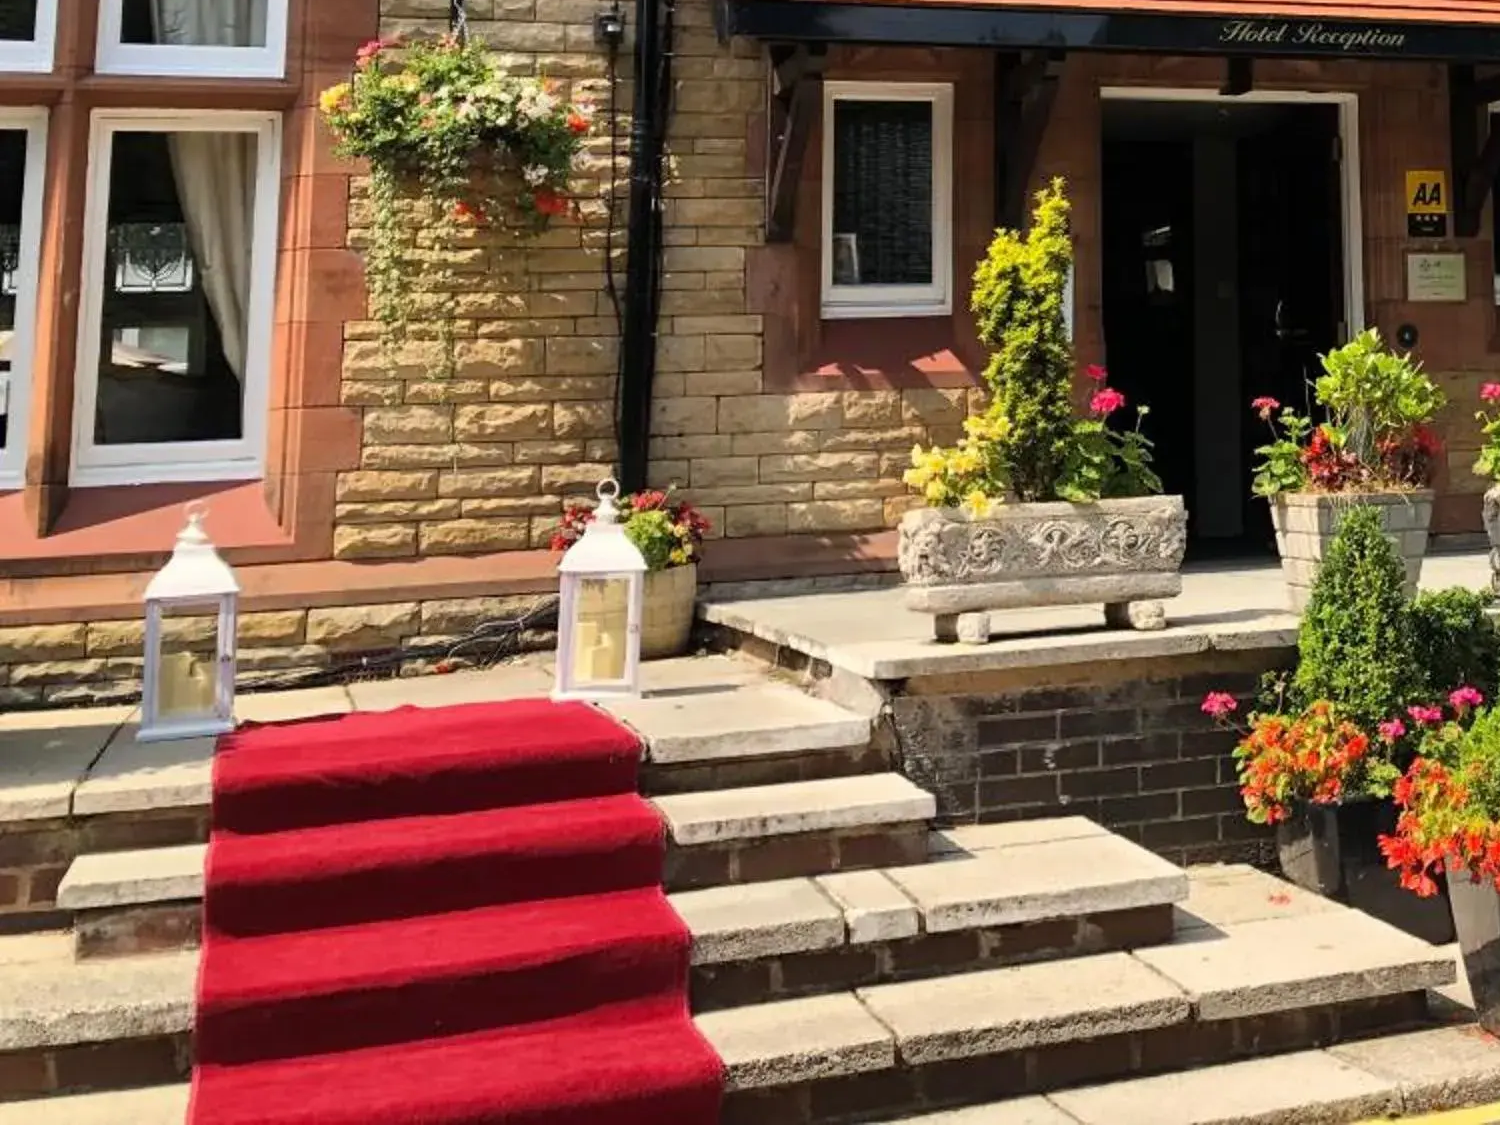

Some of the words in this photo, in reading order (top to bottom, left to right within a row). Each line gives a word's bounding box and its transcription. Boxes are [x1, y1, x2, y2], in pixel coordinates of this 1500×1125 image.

[1219, 20, 1289, 43] Hotel
[1292, 22, 1405, 50] Reception
[1412, 182, 1441, 206] AA
